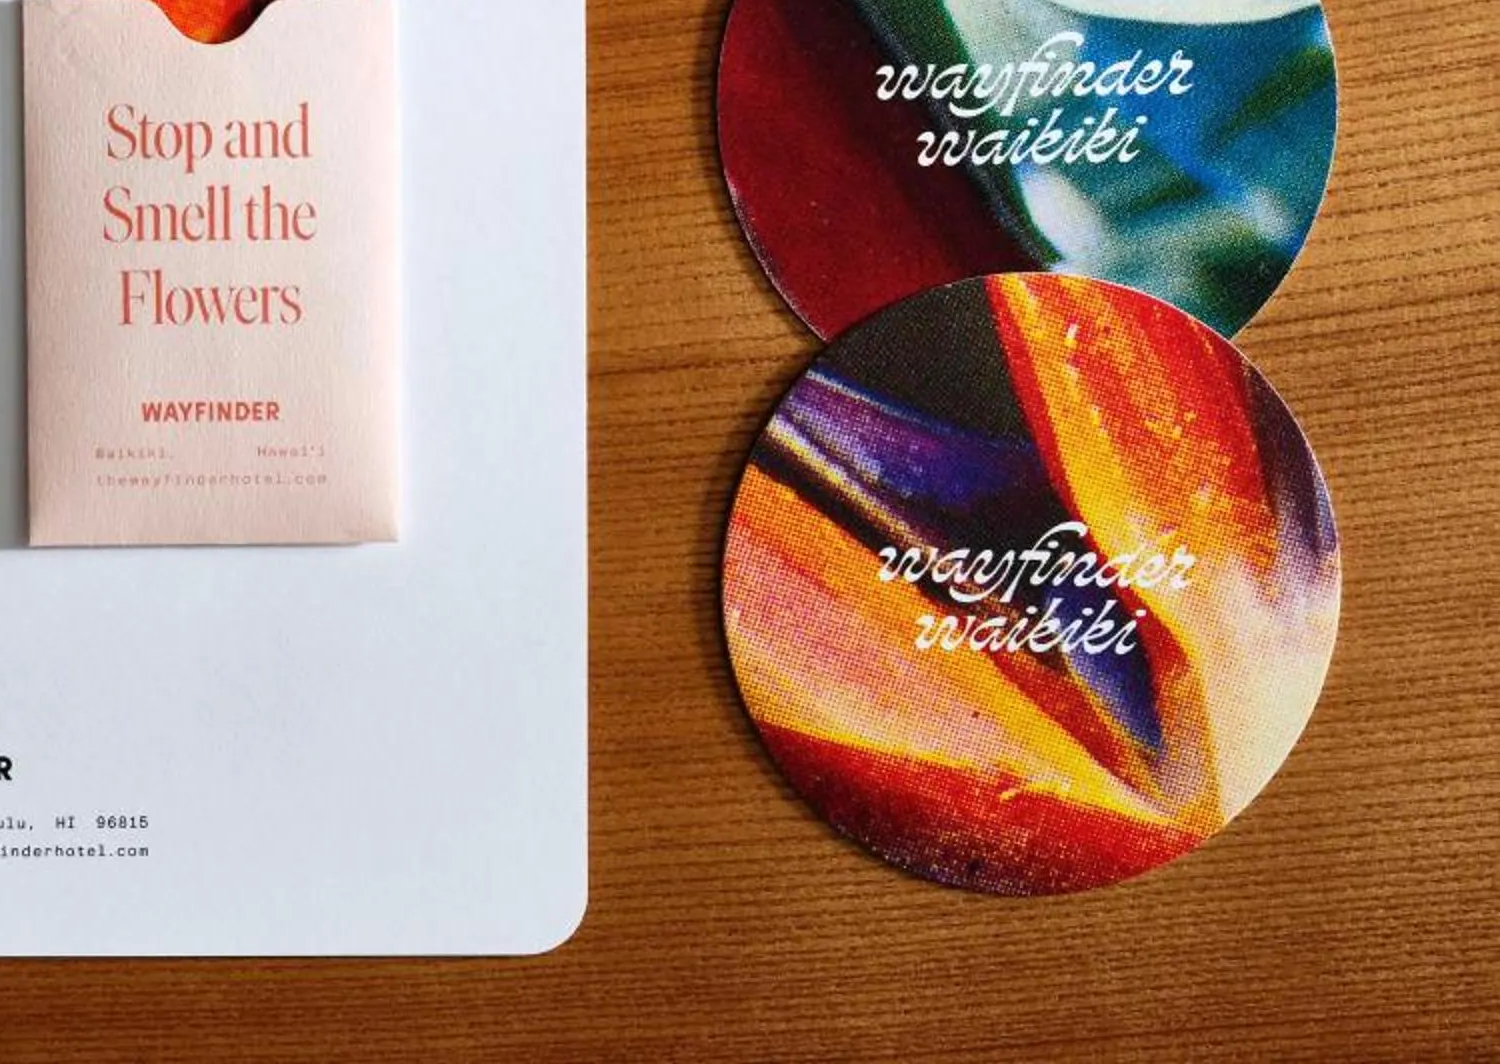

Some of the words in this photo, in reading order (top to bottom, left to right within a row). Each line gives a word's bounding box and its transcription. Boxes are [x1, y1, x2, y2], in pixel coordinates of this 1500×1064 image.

[875, 30, 1194, 118] wayfinder
[106, 102, 212, 174] Stop
[224, 102, 312, 160] and
[916, 107, 1148, 167] waikiki
[102, 186, 232, 243] Smell
[243, 186, 316, 242] the
[118, 269, 302, 327] Flowers
[141, 401, 280, 422] WAYFINDER
[877, 521, 1196, 604] wayfinder
[915, 598, 1147, 655] waikiki
[55, 815, 75, 829] HI
[96, 815, 149, 830] 96815
